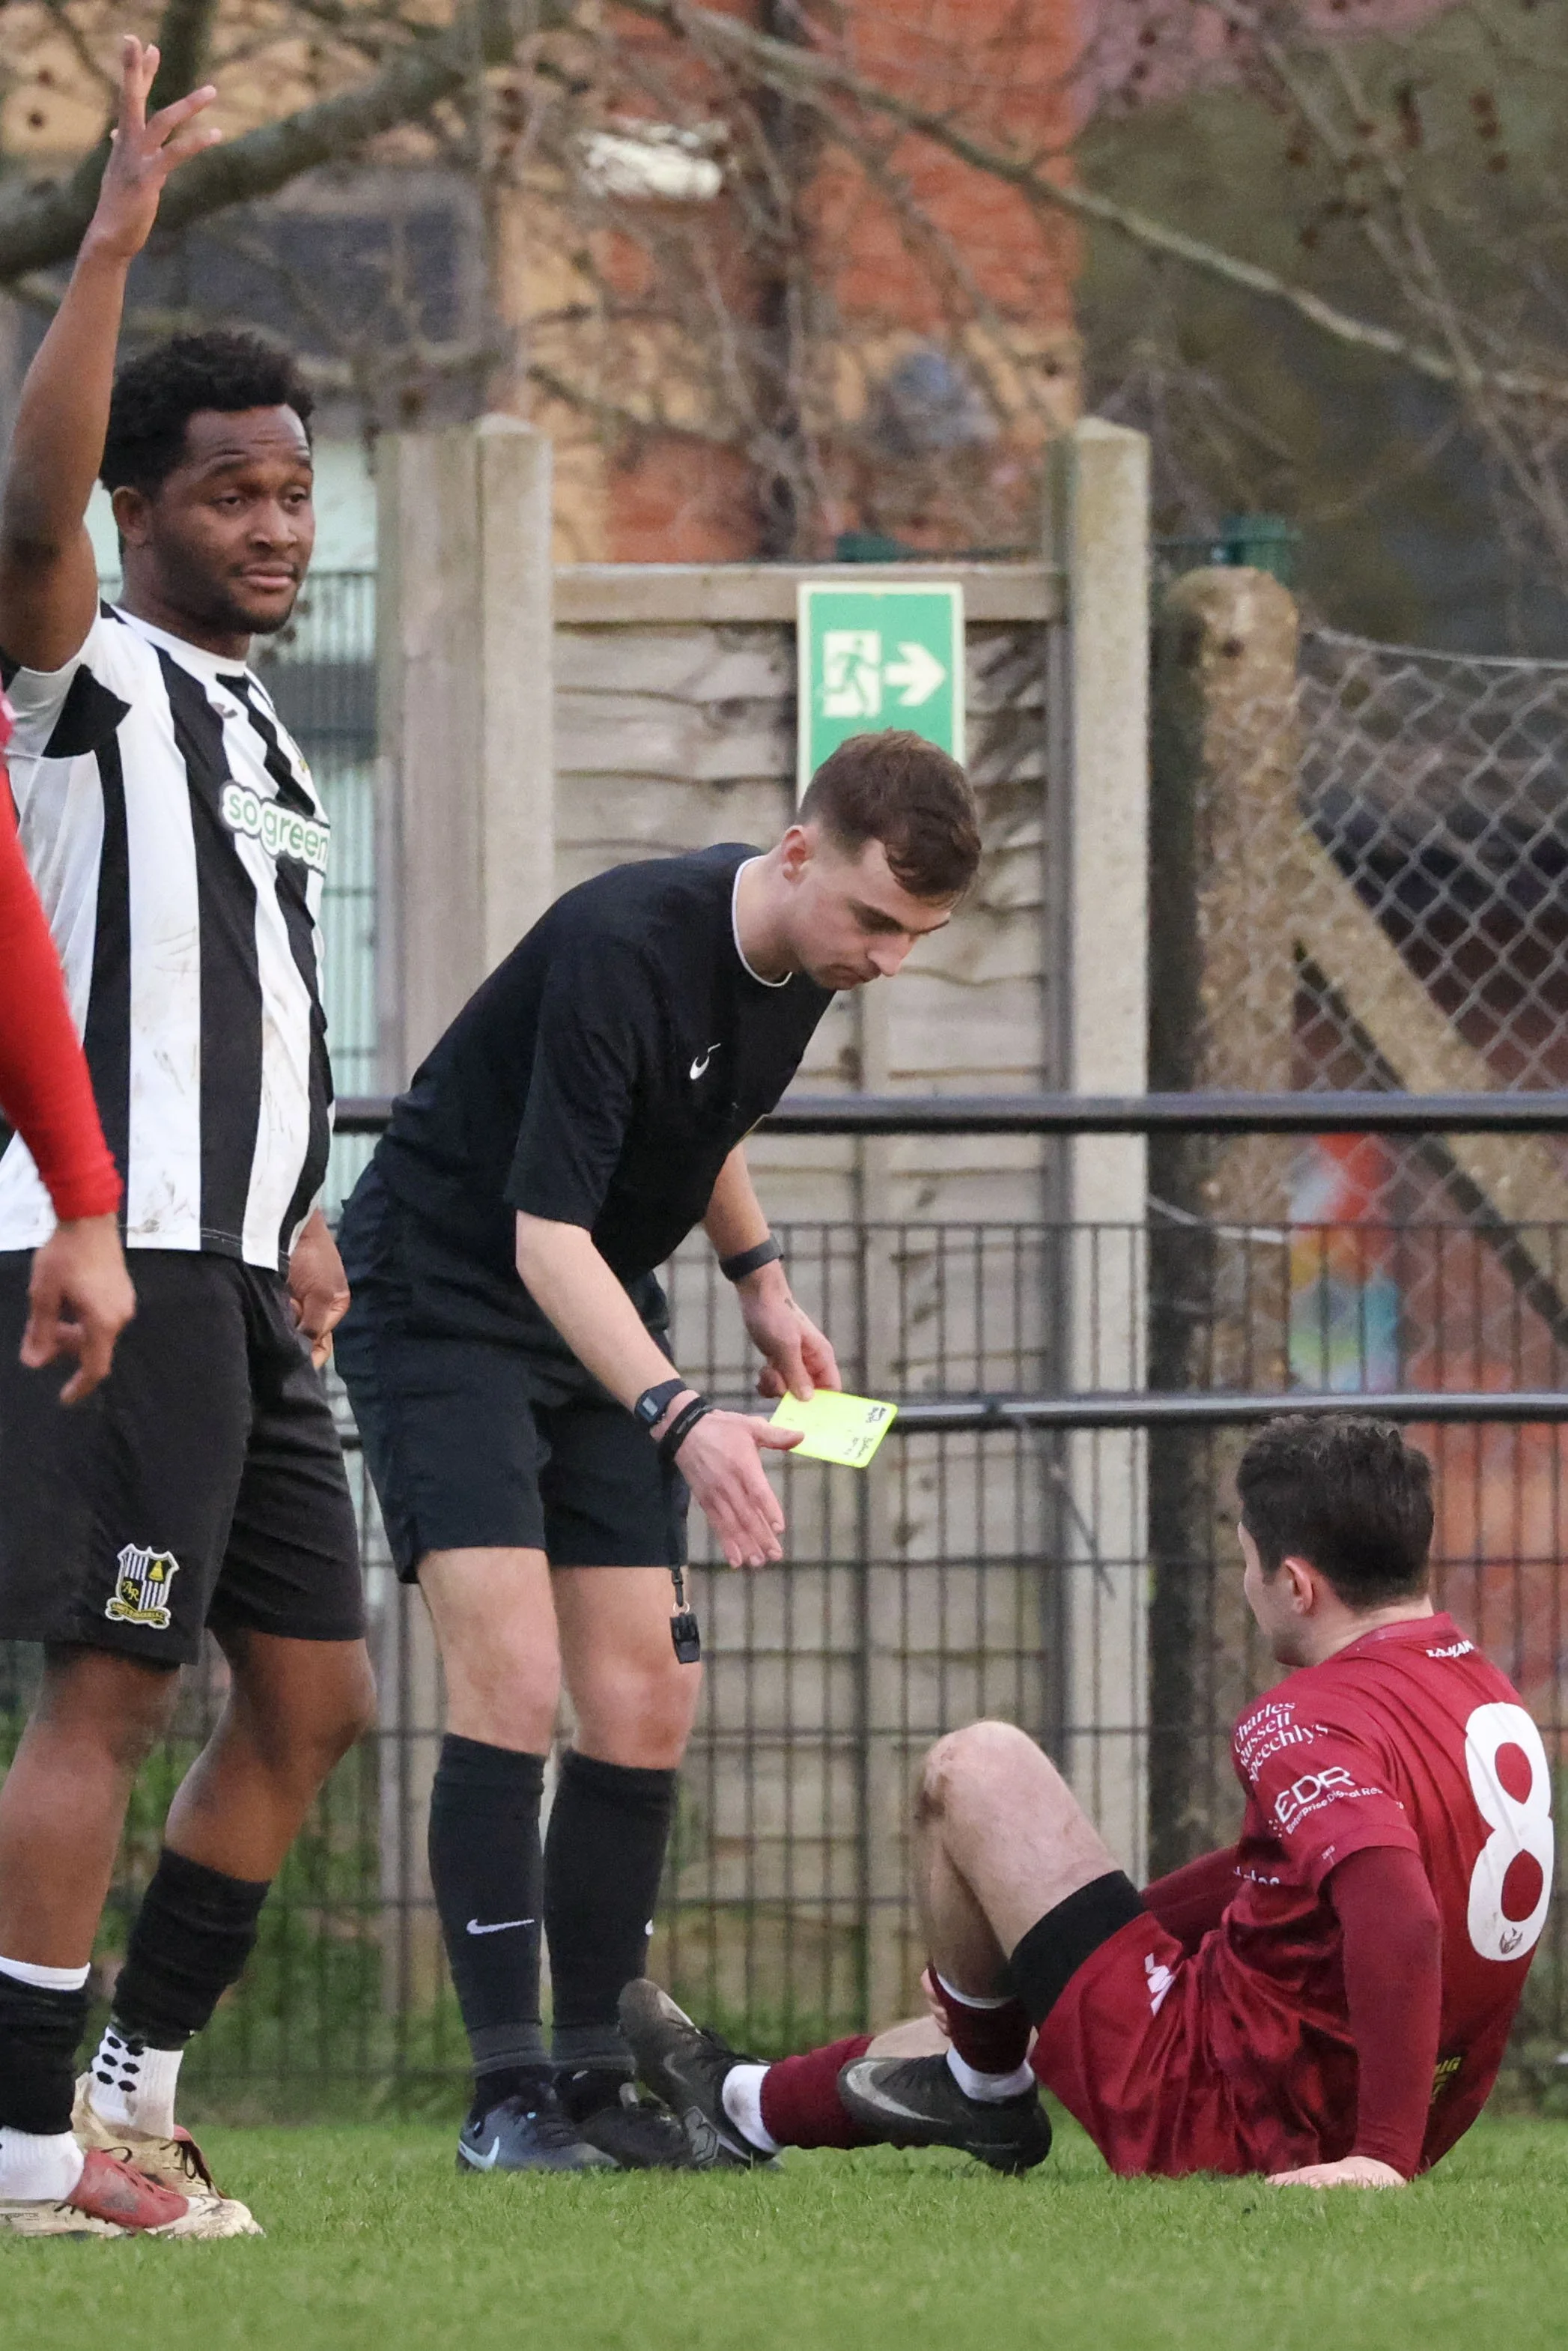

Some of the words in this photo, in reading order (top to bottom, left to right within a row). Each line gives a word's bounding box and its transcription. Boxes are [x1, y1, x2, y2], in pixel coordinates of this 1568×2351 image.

[1274, 1766, 1355, 1823] EDR
[1286, 1799, 1328, 1834] Enterprise
[1465, 1702, 1555, 1962] 8
